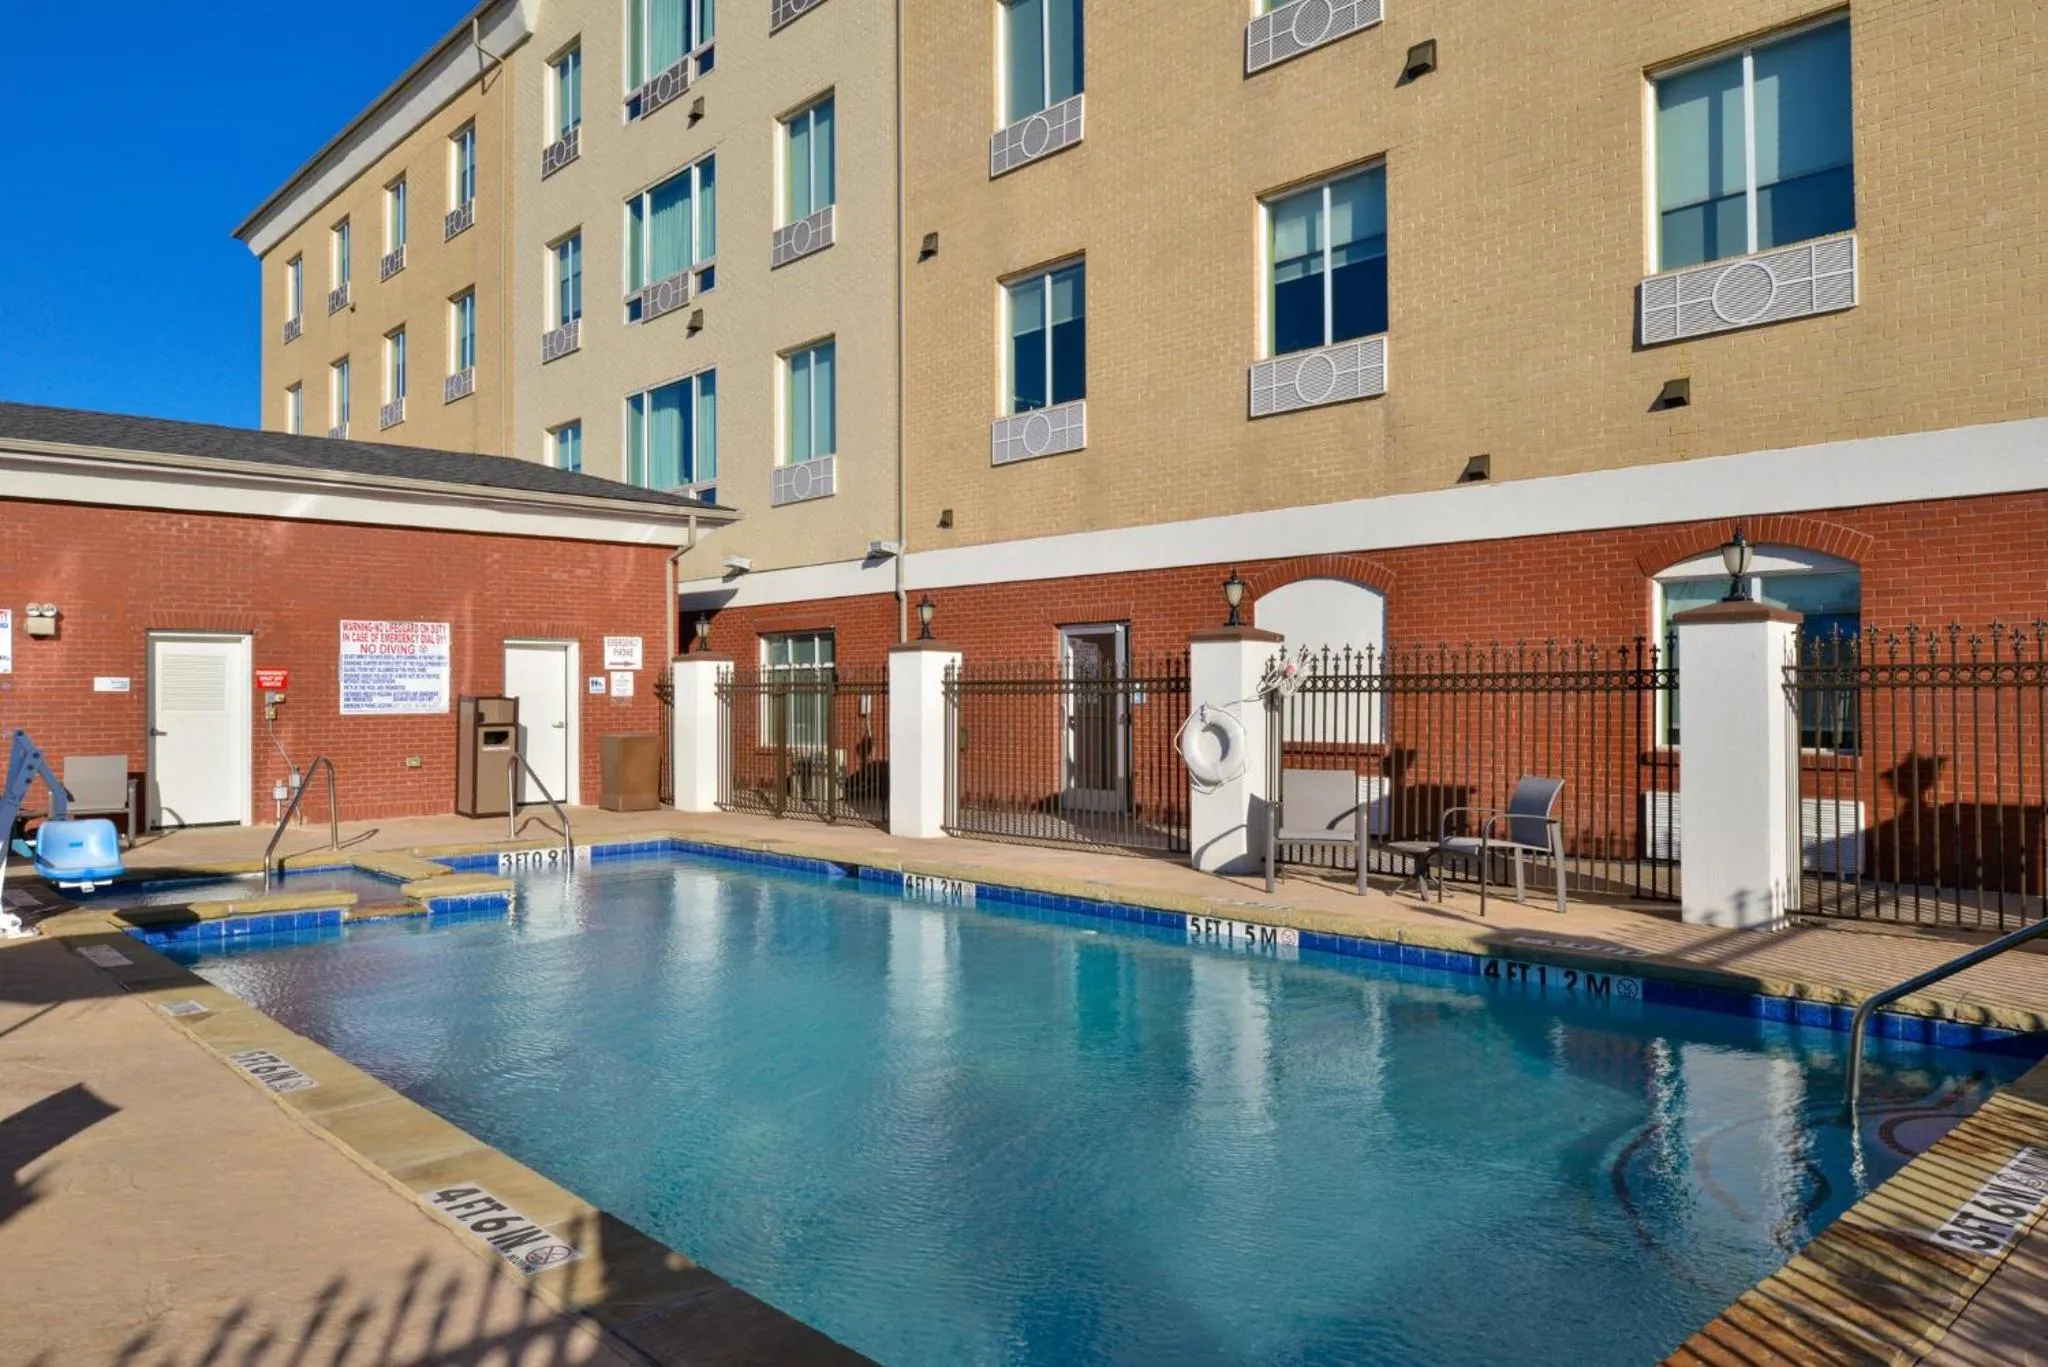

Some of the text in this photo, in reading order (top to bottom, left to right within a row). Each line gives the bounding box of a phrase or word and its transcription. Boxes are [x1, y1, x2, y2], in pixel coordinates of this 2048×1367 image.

[385, 623, 419, 634] LIFEGUARD
[420, 624, 429, 634] ON
[430, 624, 446, 634] DUTY
[352, 632, 369, 643] CASE
[381, 633, 419, 644] EMERGENCY
[360, 644, 416, 655] NO DIVING
